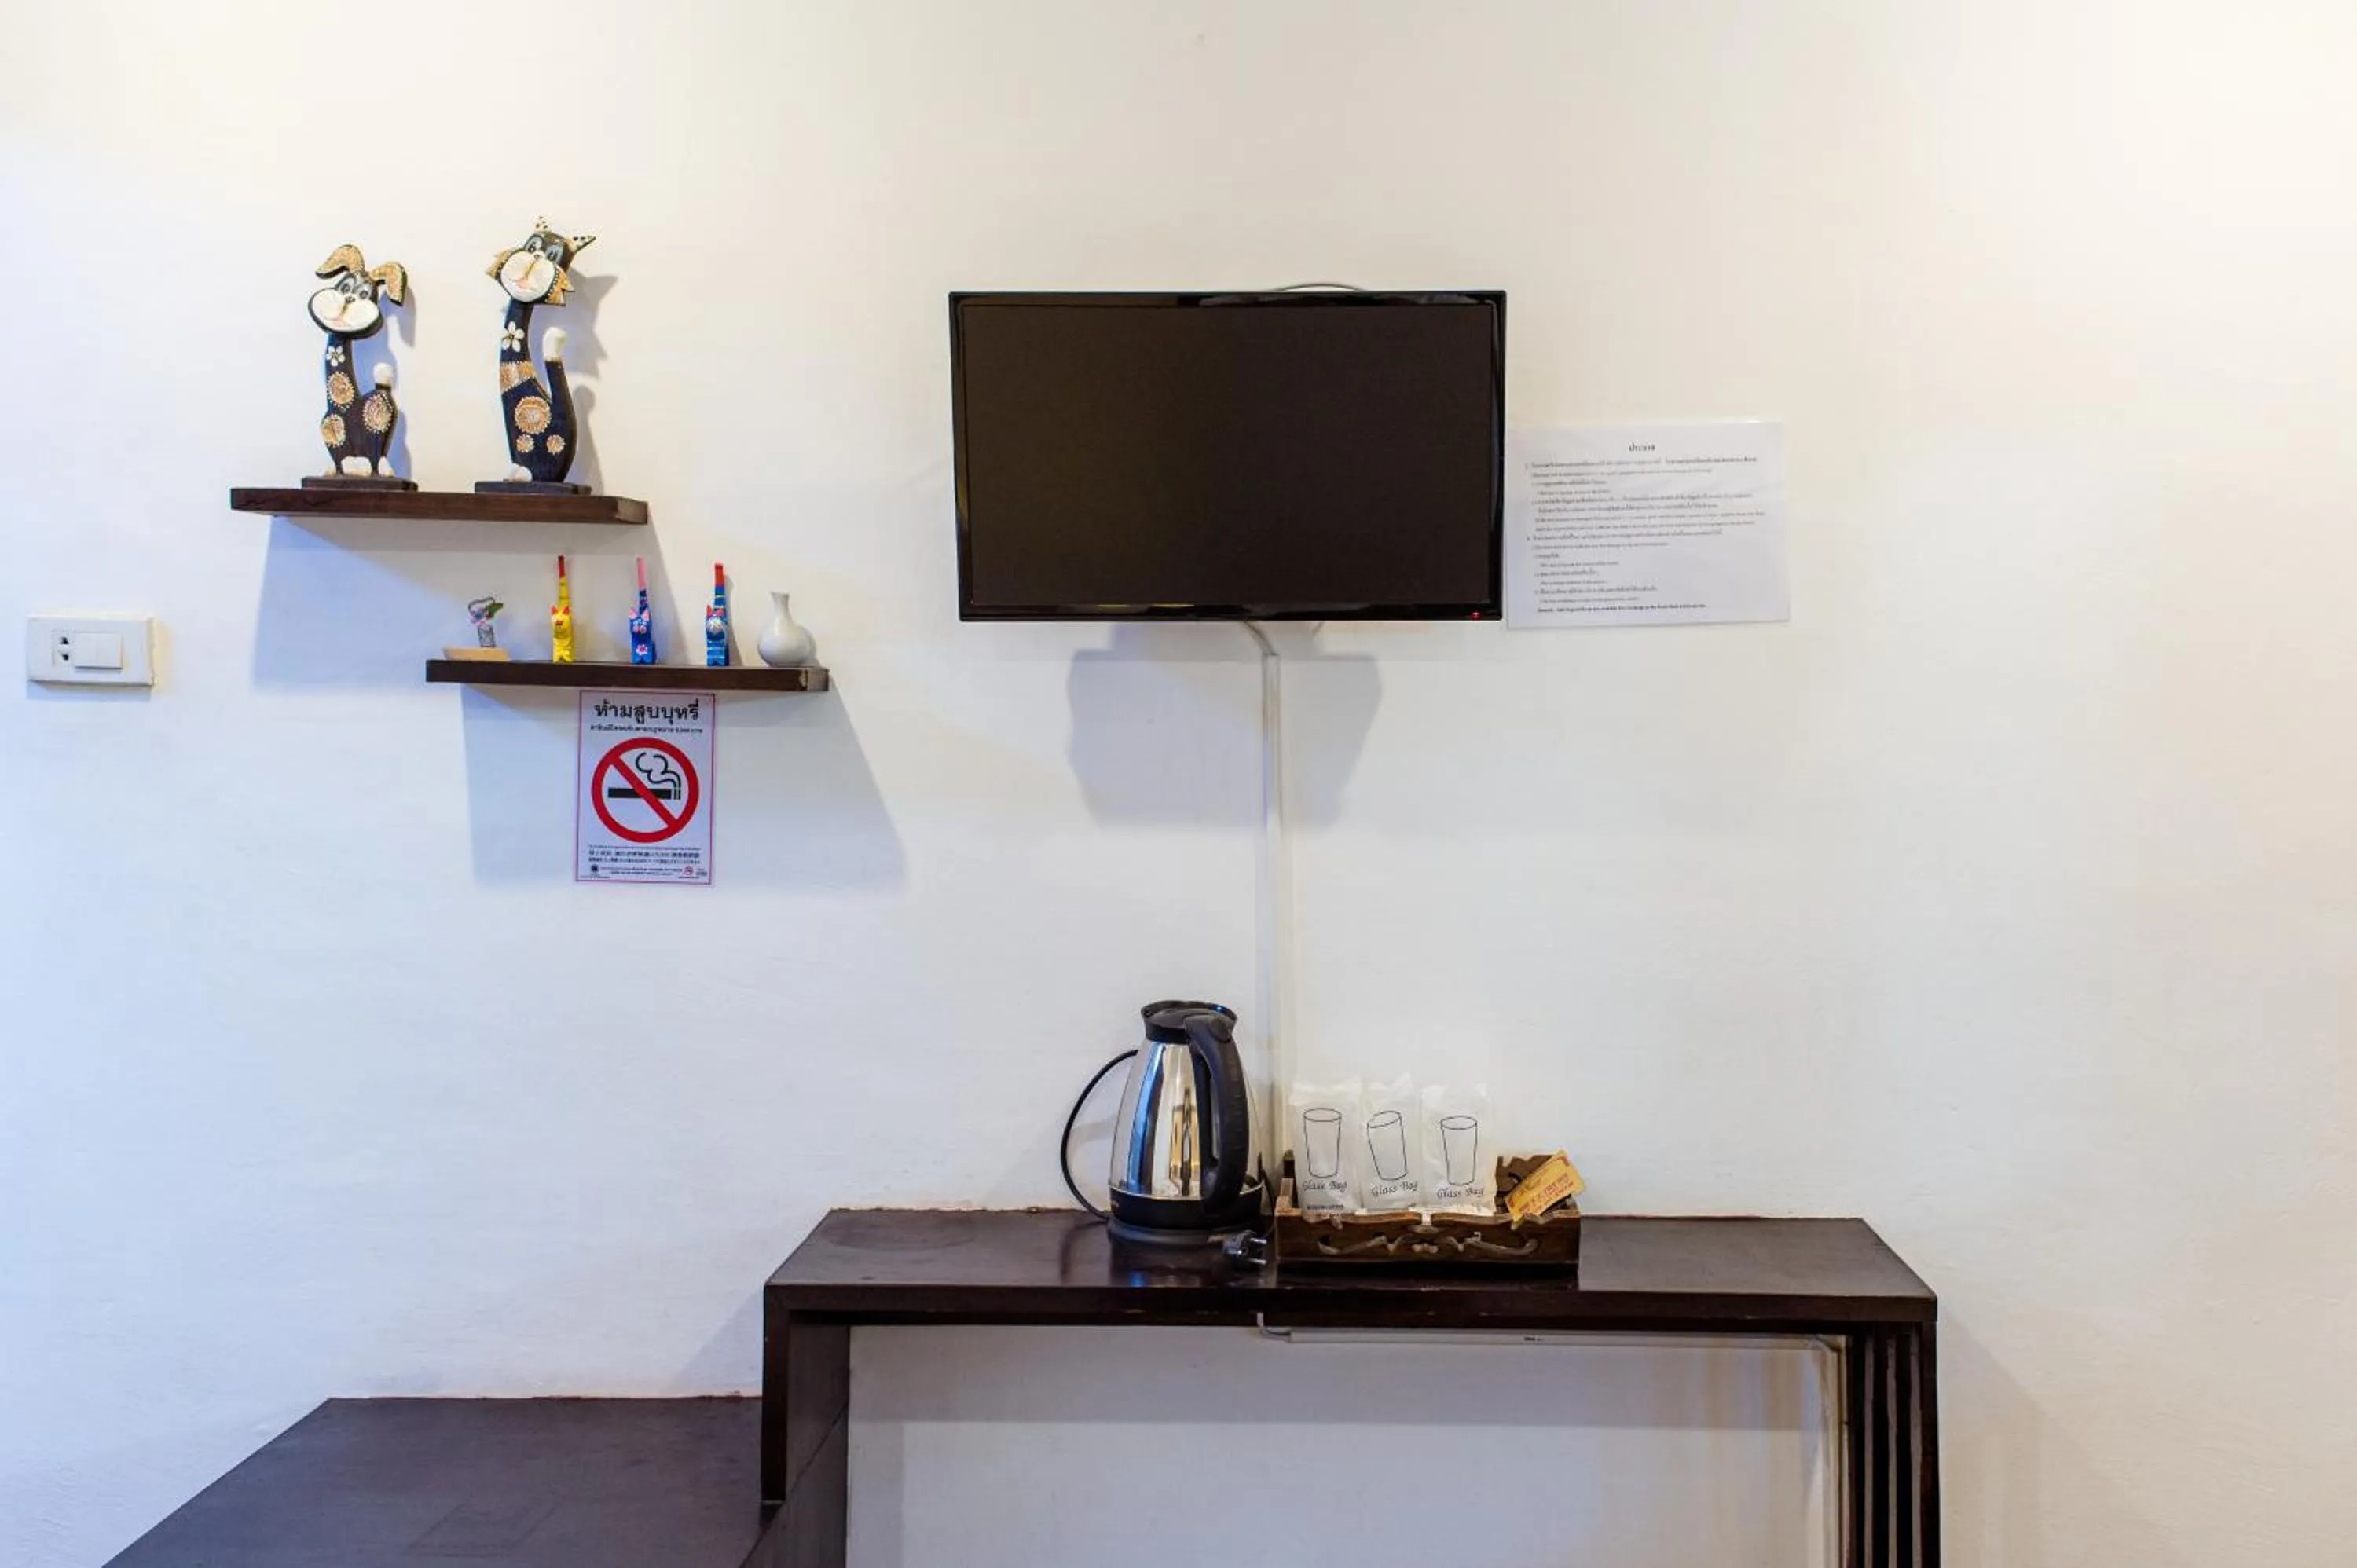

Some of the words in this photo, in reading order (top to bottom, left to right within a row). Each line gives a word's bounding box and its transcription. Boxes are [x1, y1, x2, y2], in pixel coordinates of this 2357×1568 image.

[594, 698, 699, 724] ห้ามสูบบุหรี่
[1302, 1179, 1325, 1191] Glass
[1329, 1181, 1347, 1193] Bag
[1371, 1183, 1396, 1197] Glass
[1399, 1181, 1418, 1192] Bag
[1436, 1187, 1461, 1199] Glass
[1466, 1187, 1484, 1198] Bag
